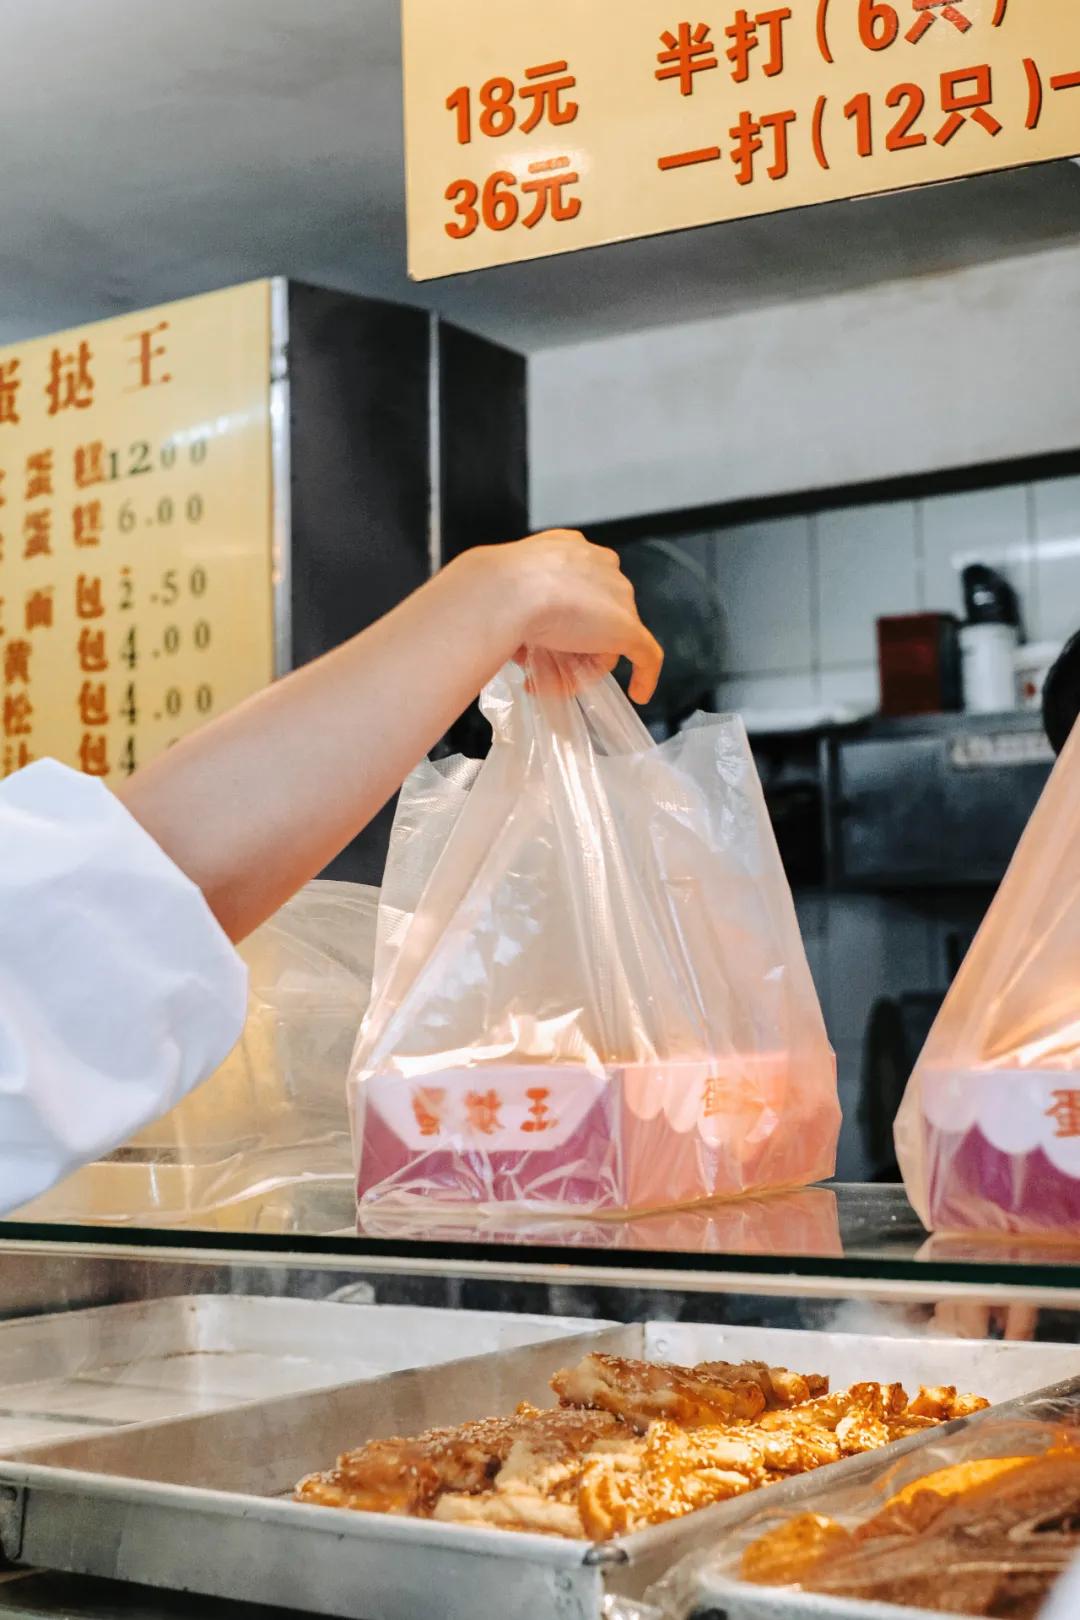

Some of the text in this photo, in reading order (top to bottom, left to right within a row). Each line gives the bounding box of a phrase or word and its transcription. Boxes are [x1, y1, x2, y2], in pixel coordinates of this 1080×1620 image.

[446, 60, 579, 144] 18元
[444, 156, 582, 239] 36元
[117, 494, 204, 534] 6.00
[118, 618, 211, 671] 4.00
[118, 684, 213, 726] 4.00
